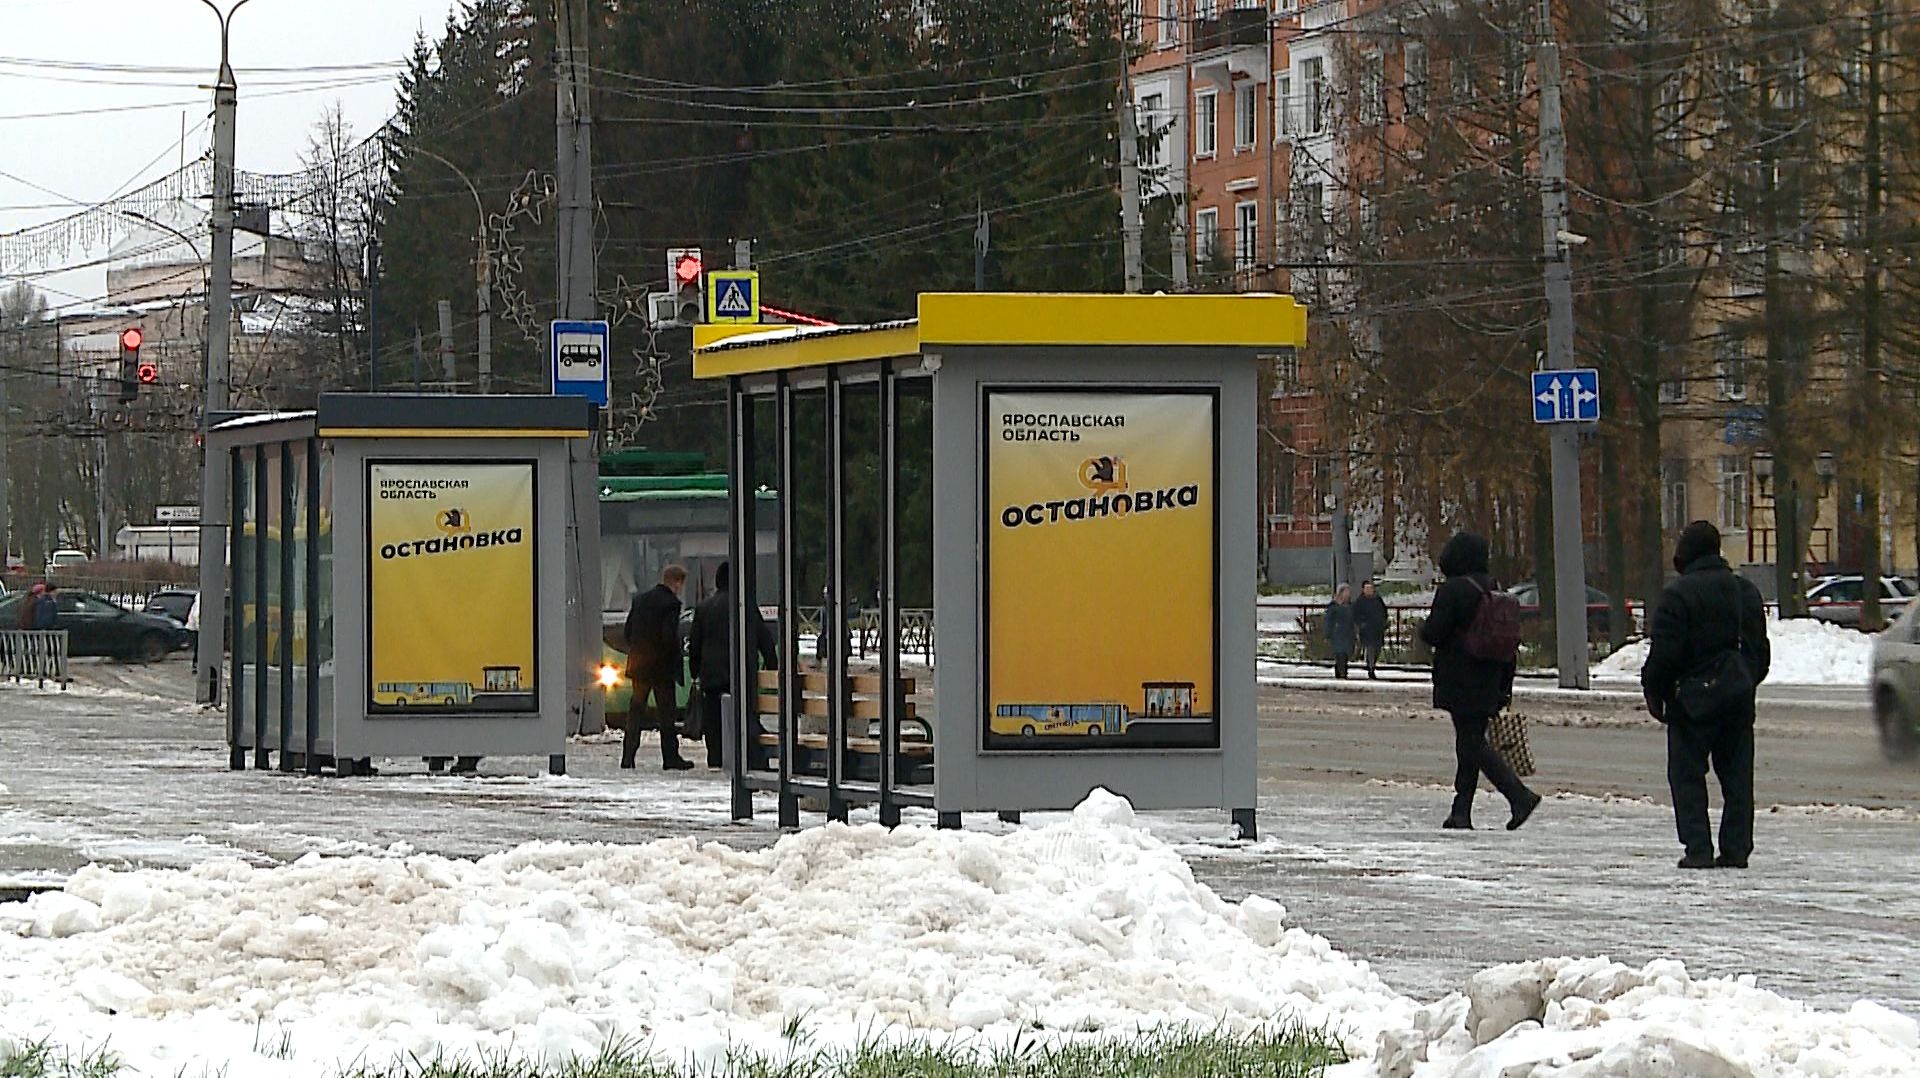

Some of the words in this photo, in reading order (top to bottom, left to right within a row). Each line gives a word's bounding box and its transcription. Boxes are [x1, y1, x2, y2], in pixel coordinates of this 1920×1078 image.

[1002, 414, 1125, 427] ЯРОСЛАВСКАЯ
[1002, 429, 1080, 441] ОБЛАСТЬ
[380, 480, 469, 489] ЯРОСЛАВСКАЯ
[380, 490, 437, 499] ОБЛАСТЬ
[1001, 484, 1199, 527] остановка
[380, 528, 522, 559] остановка
